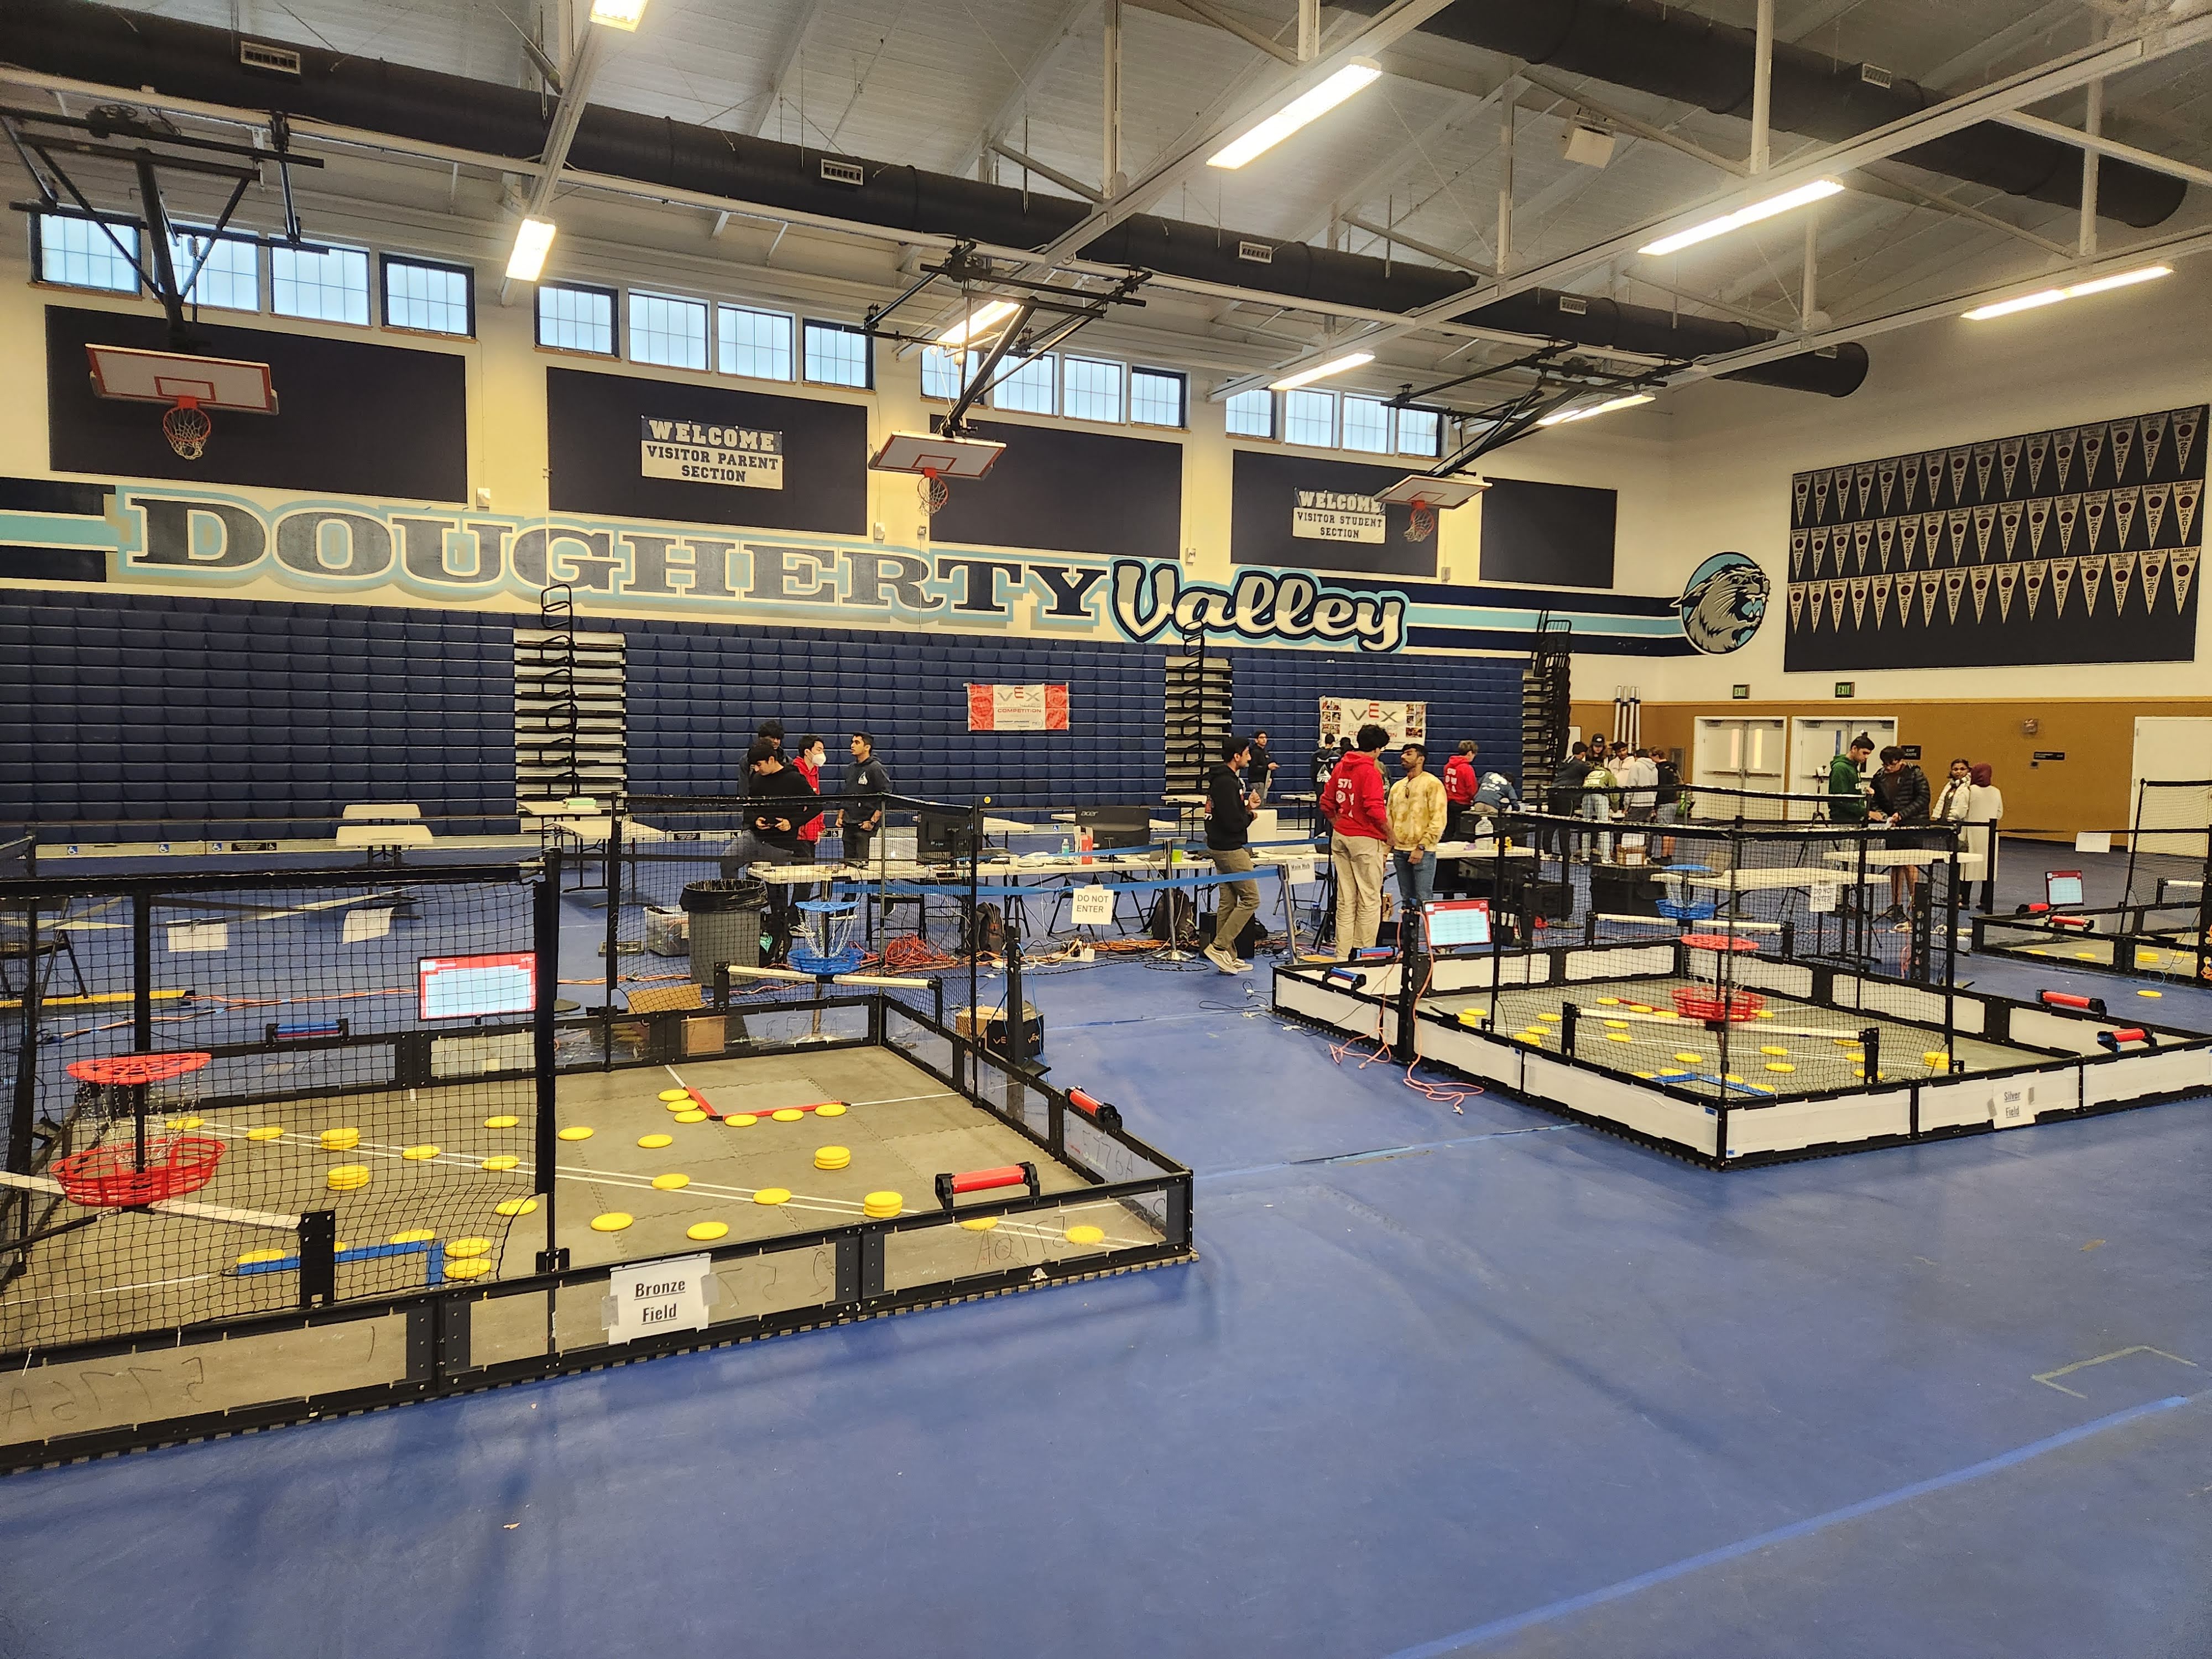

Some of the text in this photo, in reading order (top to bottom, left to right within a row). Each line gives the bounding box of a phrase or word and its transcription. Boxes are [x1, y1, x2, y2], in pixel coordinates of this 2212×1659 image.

[649, 419, 774, 452] WELCOME
[646, 445, 778, 470] VISITOR PARENT
[681, 465, 746, 482] SECTION
[1299, 491, 1382, 513] WELCOME
[1297, 512, 1383, 528] VISITOR STUDENT
[1320, 526, 1359, 539] SECTION
[126, 492, 1406, 653] DOUGHERTY Valley
[998, 686, 1040, 702] VEX
[1734, 687, 1746, 697] EXIT
[1837, 685, 1850, 695] EXIT
[1350, 703, 1399, 723] VEX
[1092, 895, 1109, 903] NOT
[1077, 905, 1104, 913] ENTER
[2004, 1091, 2021, 1101] Silver
[2006, 1105, 2020, 1117] Field
[635, 1280, 686, 1298] Bronze
[642, 1303, 677, 1323] Field
